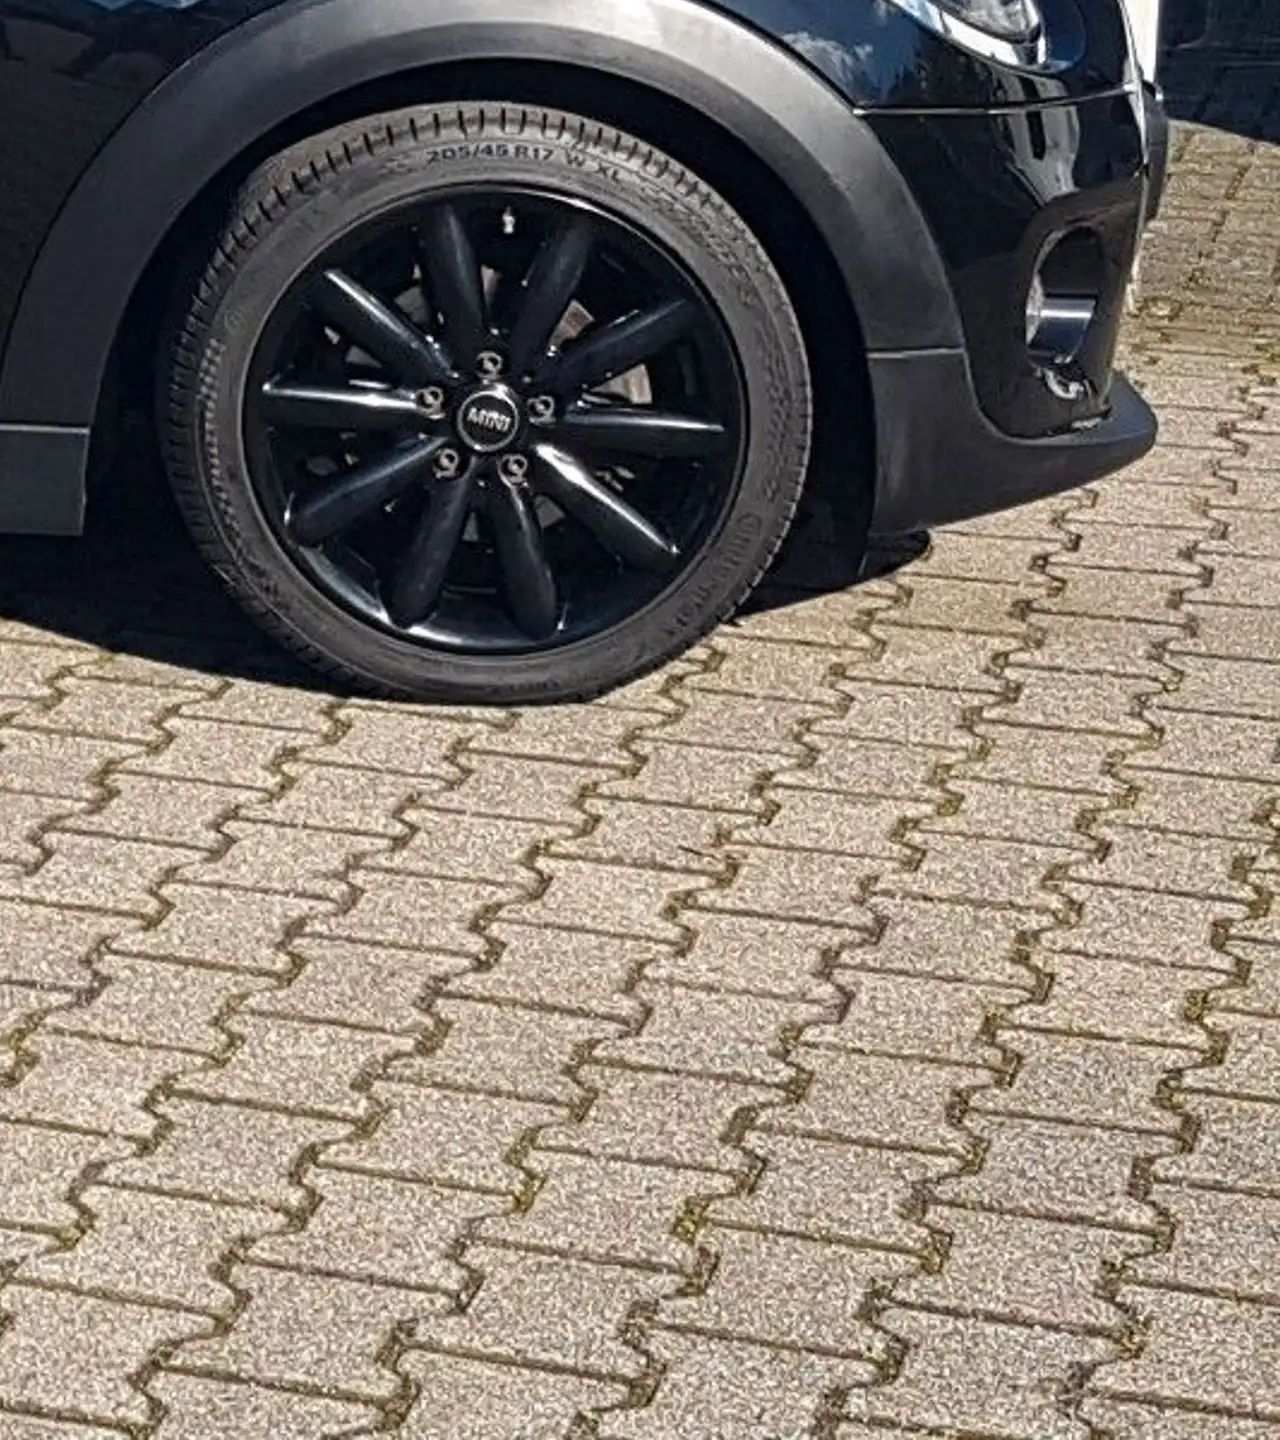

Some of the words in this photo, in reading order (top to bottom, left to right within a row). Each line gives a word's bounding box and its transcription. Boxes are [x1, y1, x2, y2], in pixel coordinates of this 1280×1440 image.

[425, 142, 509, 164] 205/45
[514, 145, 555, 161] R17
[467, 407, 511, 433] MINI
